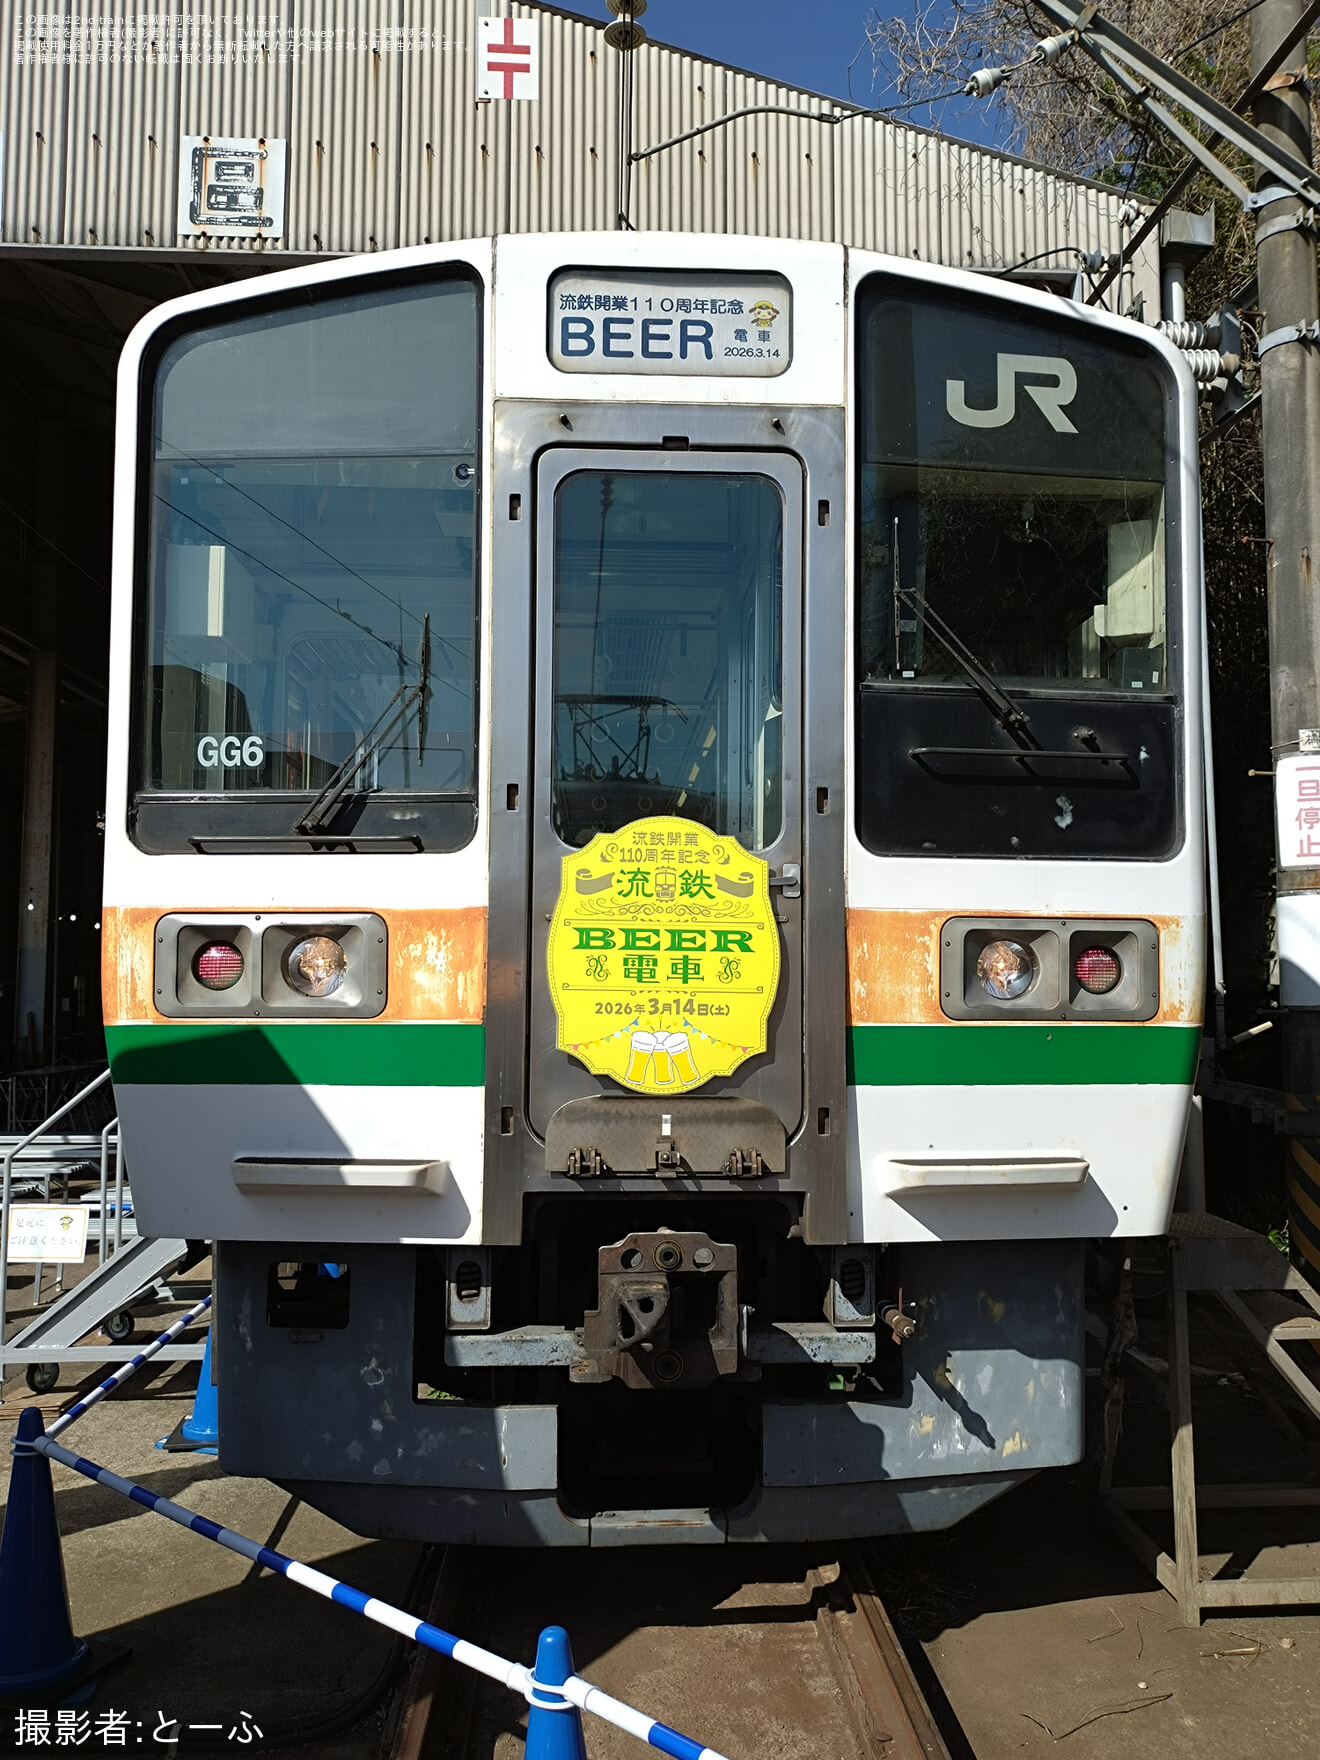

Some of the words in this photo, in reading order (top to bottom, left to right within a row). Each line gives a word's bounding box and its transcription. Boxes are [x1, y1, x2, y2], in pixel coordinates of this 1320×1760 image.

[559, 294, 744, 315] 流鉄開業110周年記念
[560, 316, 714, 360] BEER
[733, 328, 771, 343] 電車
[723, 347, 781, 359] 2026.3.14
[946, 352, 1080, 434] JR
[197, 735, 264, 768] GG6
[632, 831, 699, 847] 流鉄開業
[619, 848, 710, 864] 110周年記念
[571, 926, 756, 953] BEER
[622, 953, 705, 985] 電車
[594, 997, 731, 1016] 2026年3月14日(土)
